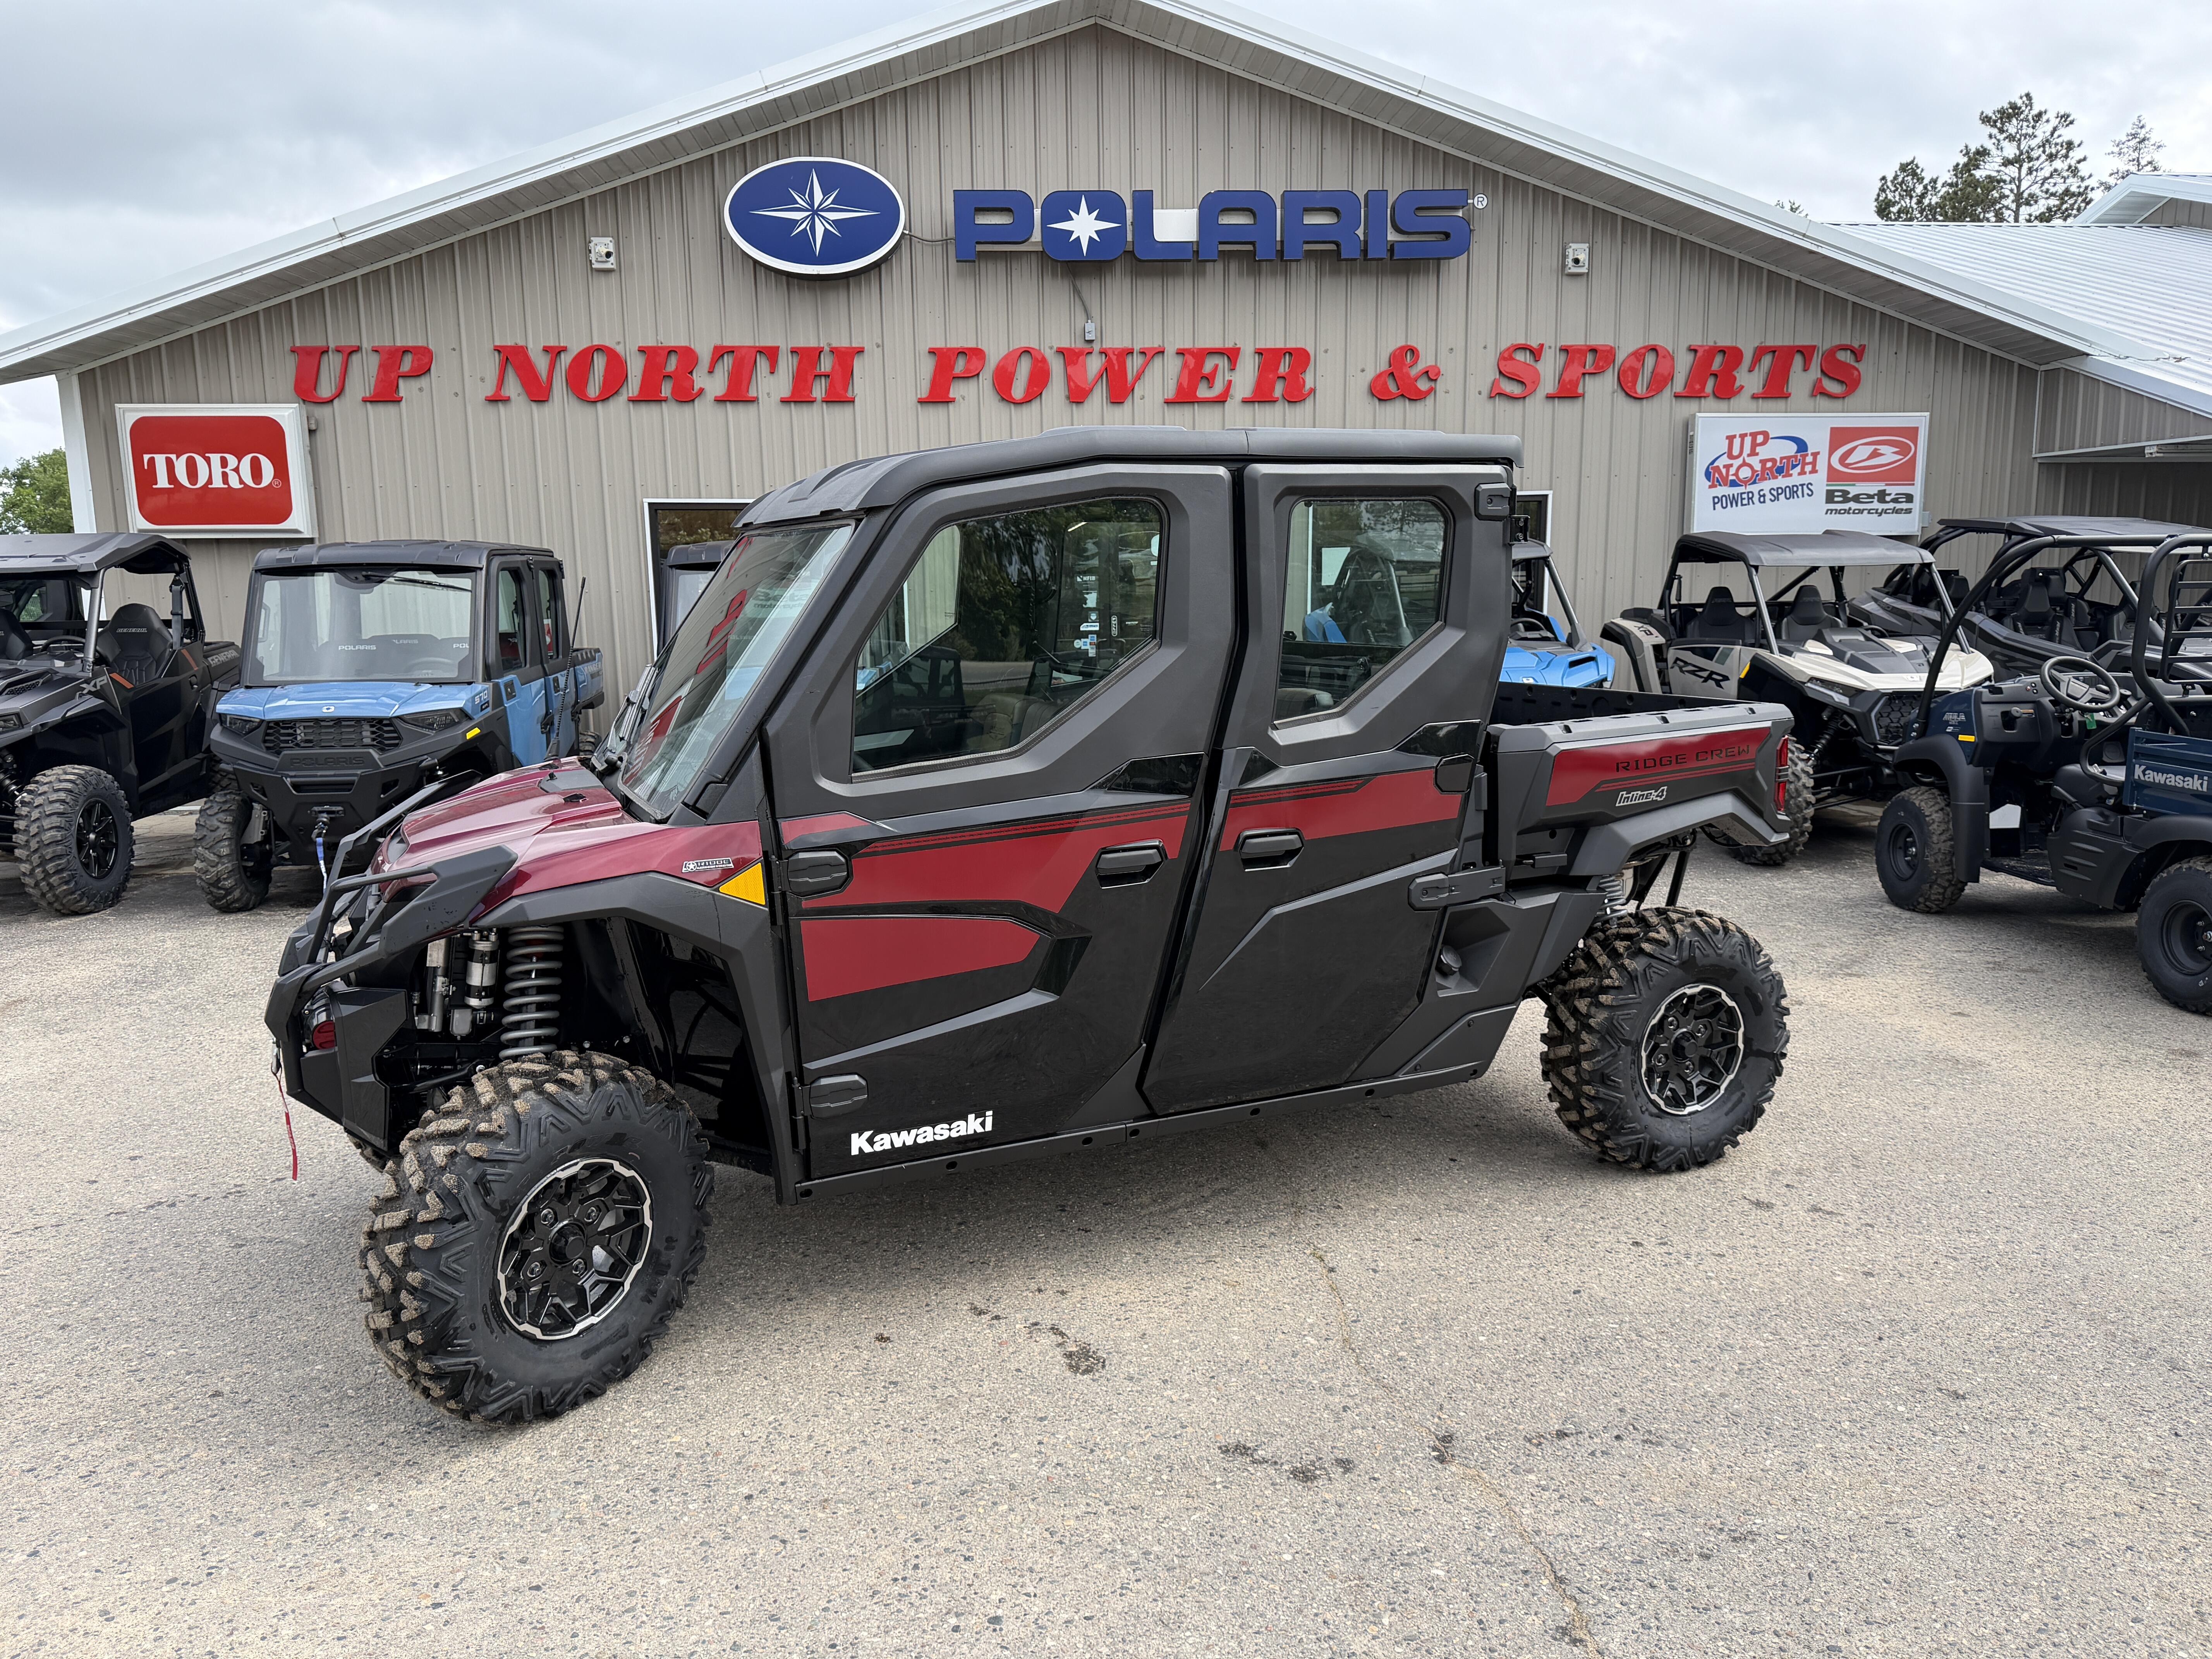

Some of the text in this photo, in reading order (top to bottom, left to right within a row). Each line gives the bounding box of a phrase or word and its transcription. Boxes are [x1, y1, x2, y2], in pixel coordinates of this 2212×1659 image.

[953, 190, 1471, 261] POLARIS
[290, 343, 1866, 404] UP NORTH POWER & SPORTS
[1725, 429, 1771, 460] UP
[143, 453, 275, 489] TORO
[1707, 451, 1820, 489] NORTH
[1712, 483, 1814, 511] POWER & SPORTS
[1824, 489, 1914, 505] Beta
[1824, 506, 1913, 517] motorcycles
[1633, 625, 1654, 636] XP
[80, 677, 108, 694] XP
[1669, 657, 1730, 690] RZR
[475, 690, 488, 704] 570
[290, 756, 365, 768] POLARIS
[1616, 745, 1750, 773] RIDGE CREW
[2134, 764, 2208, 792] Kawasaki
[1616, 786, 1668, 807] Inline-4
[850, 1110, 993, 1156] Kawasaki
